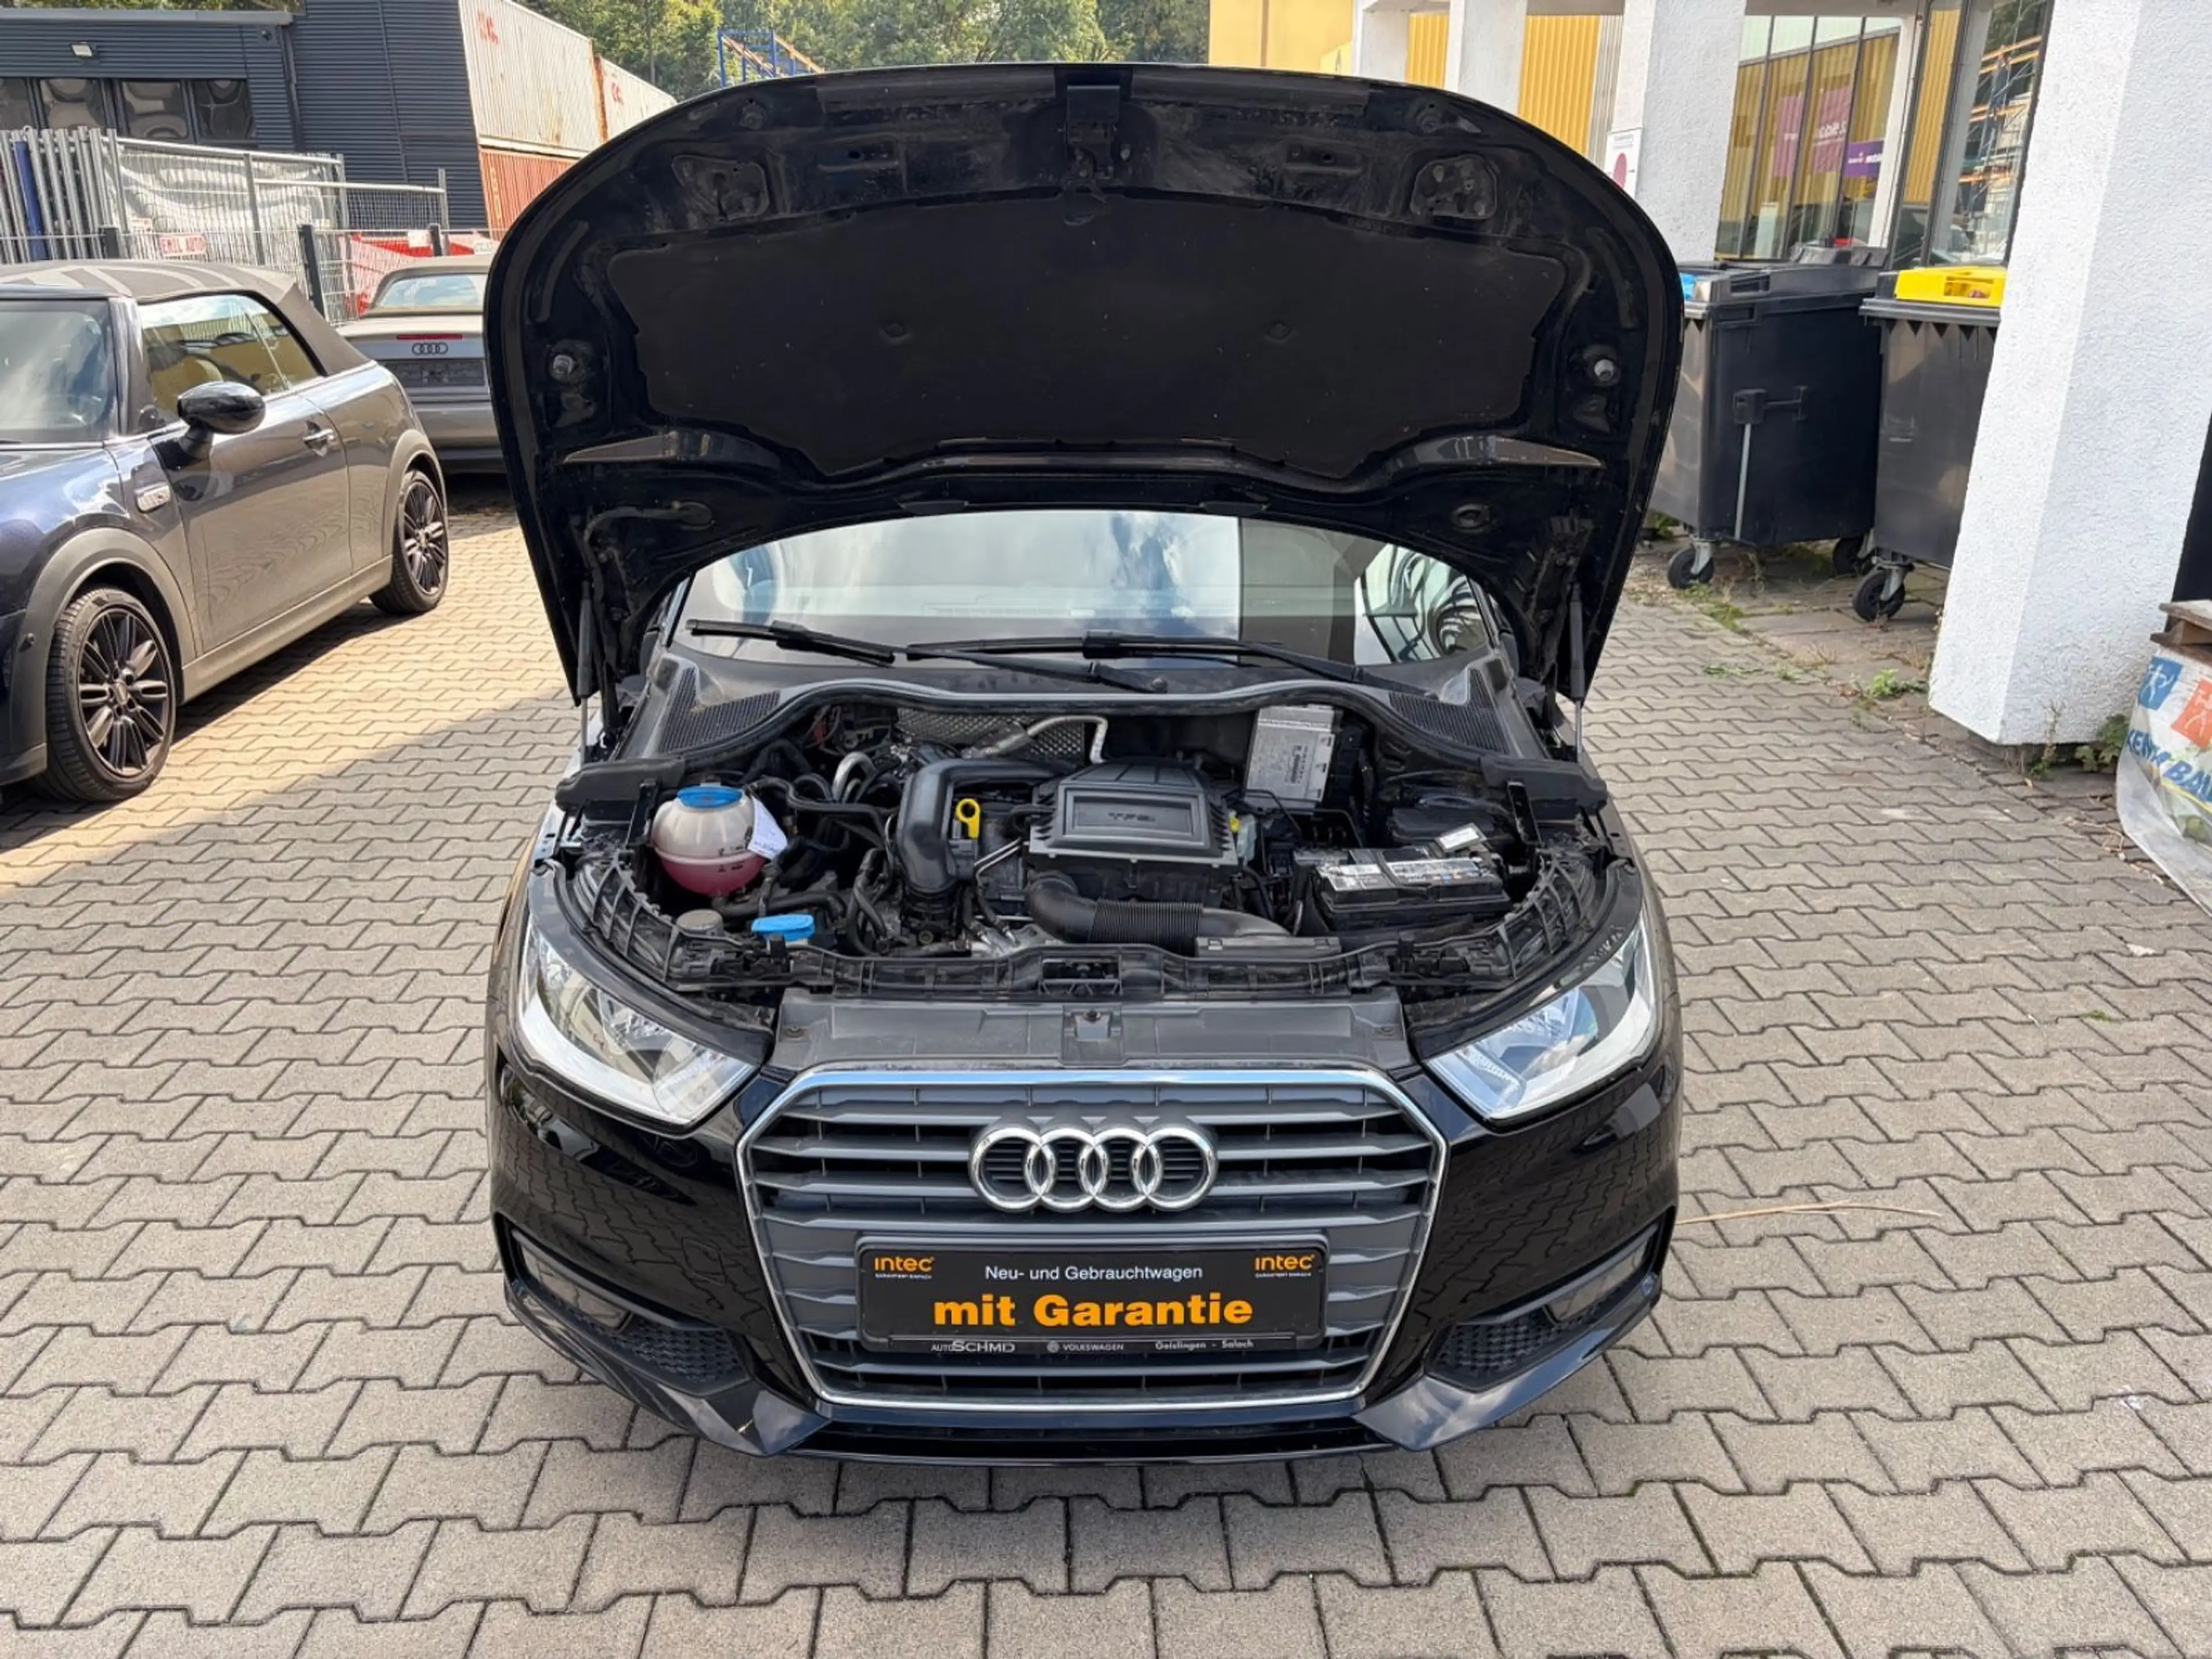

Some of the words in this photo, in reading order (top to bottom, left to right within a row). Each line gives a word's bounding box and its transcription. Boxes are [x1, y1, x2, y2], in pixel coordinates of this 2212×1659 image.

[874, 1256, 933, 1272] intec
[1255, 1255, 1313, 1270] intec
[985, 1266, 1025, 1280] Neu-
[1030, 1266, 1060, 1280] und
[1065, 1266, 1203, 1282] Gebrauchtwagen
[933, 1294, 1016, 1326] mit
[1033, 1292, 1253, 1327] Garantie
[1063, 1342, 1124, 1351] VOLKSWAGEN
